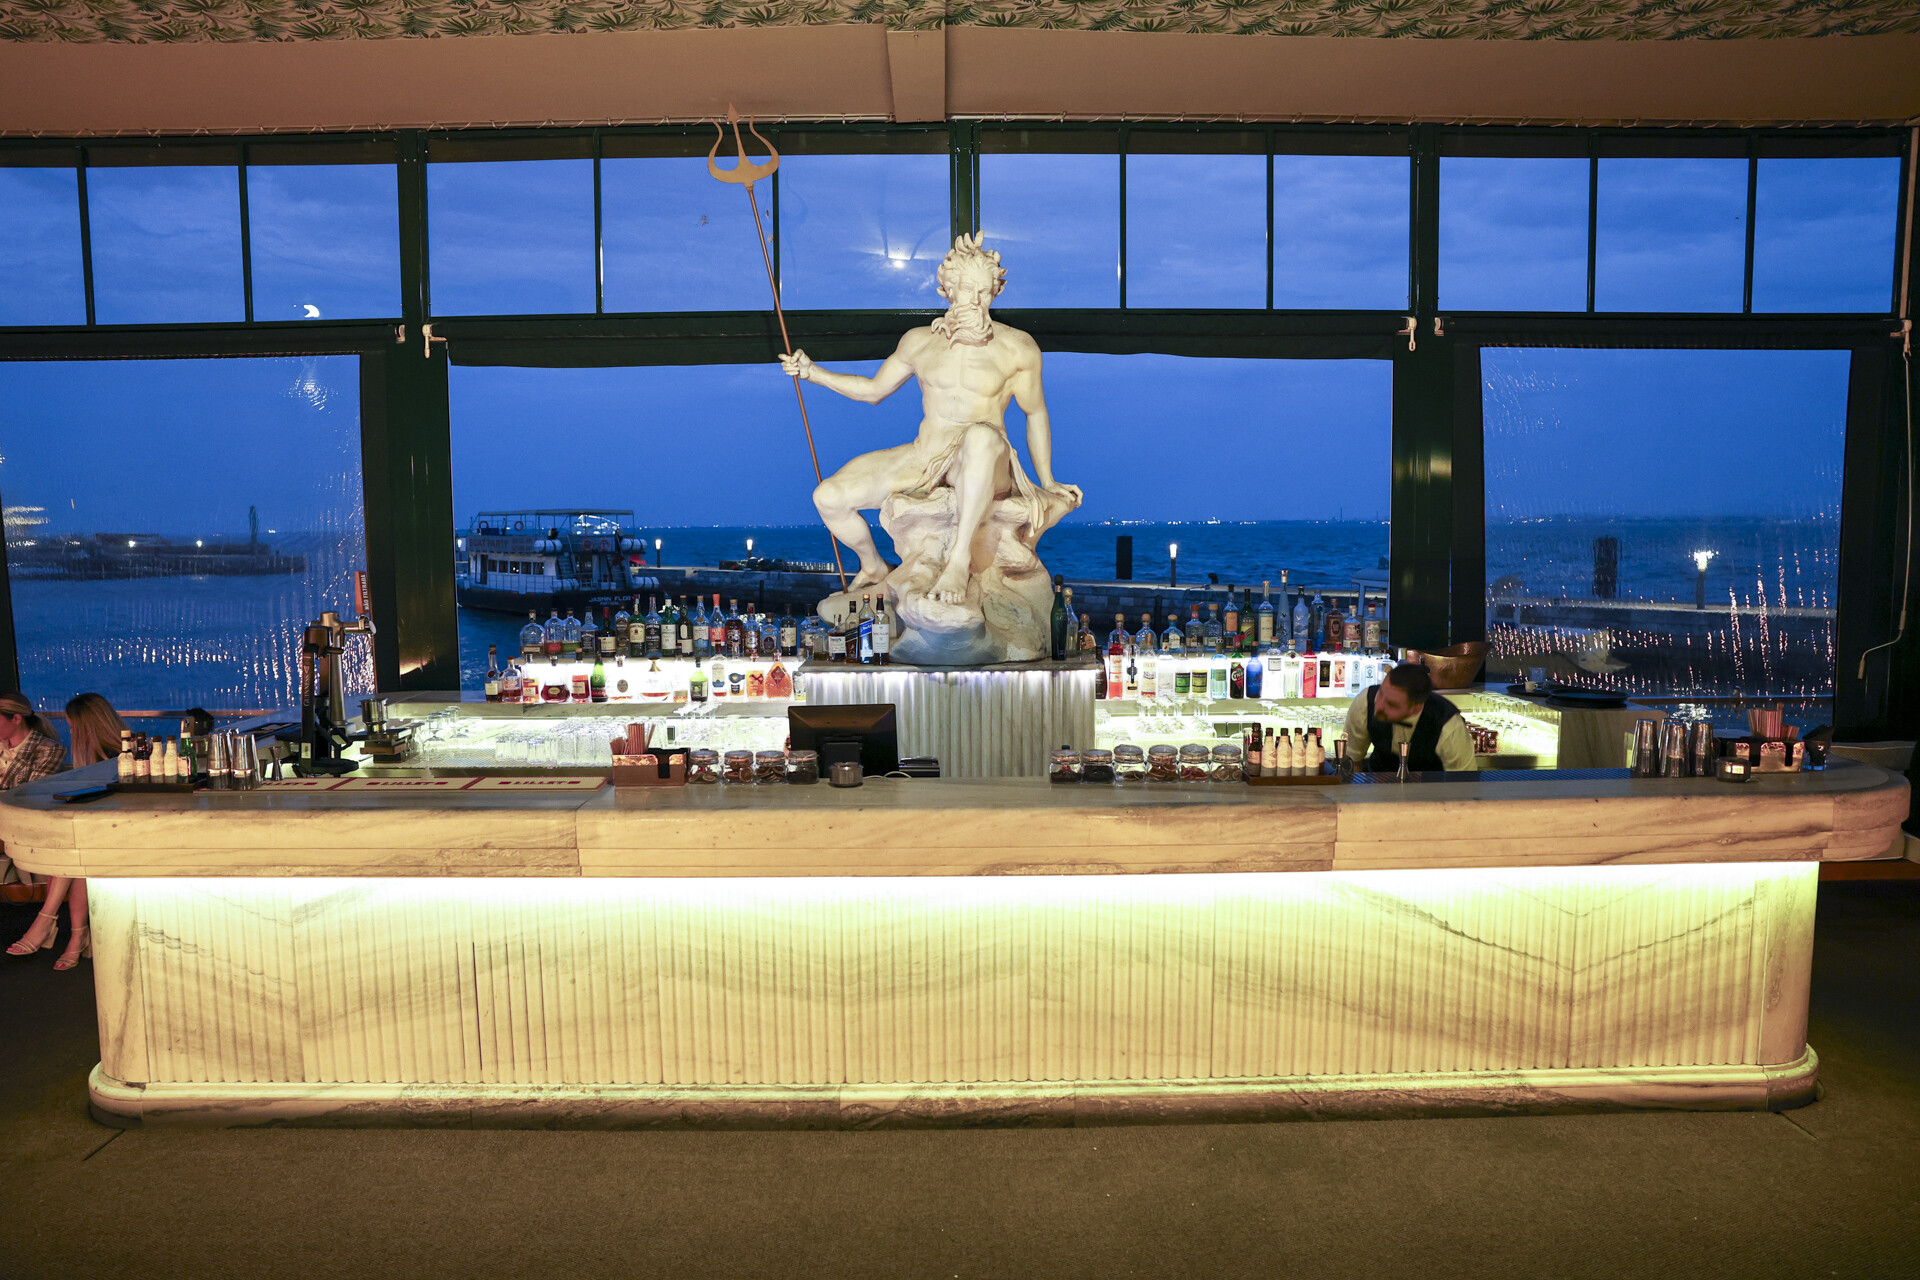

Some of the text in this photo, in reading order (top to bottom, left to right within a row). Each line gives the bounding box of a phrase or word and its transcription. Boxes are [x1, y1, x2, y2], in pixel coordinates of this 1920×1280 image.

[469, 538, 486, 548] BOAT
[487, 539, 509, 548] PARTY
[360, 574, 369, 599] FILTRADA
